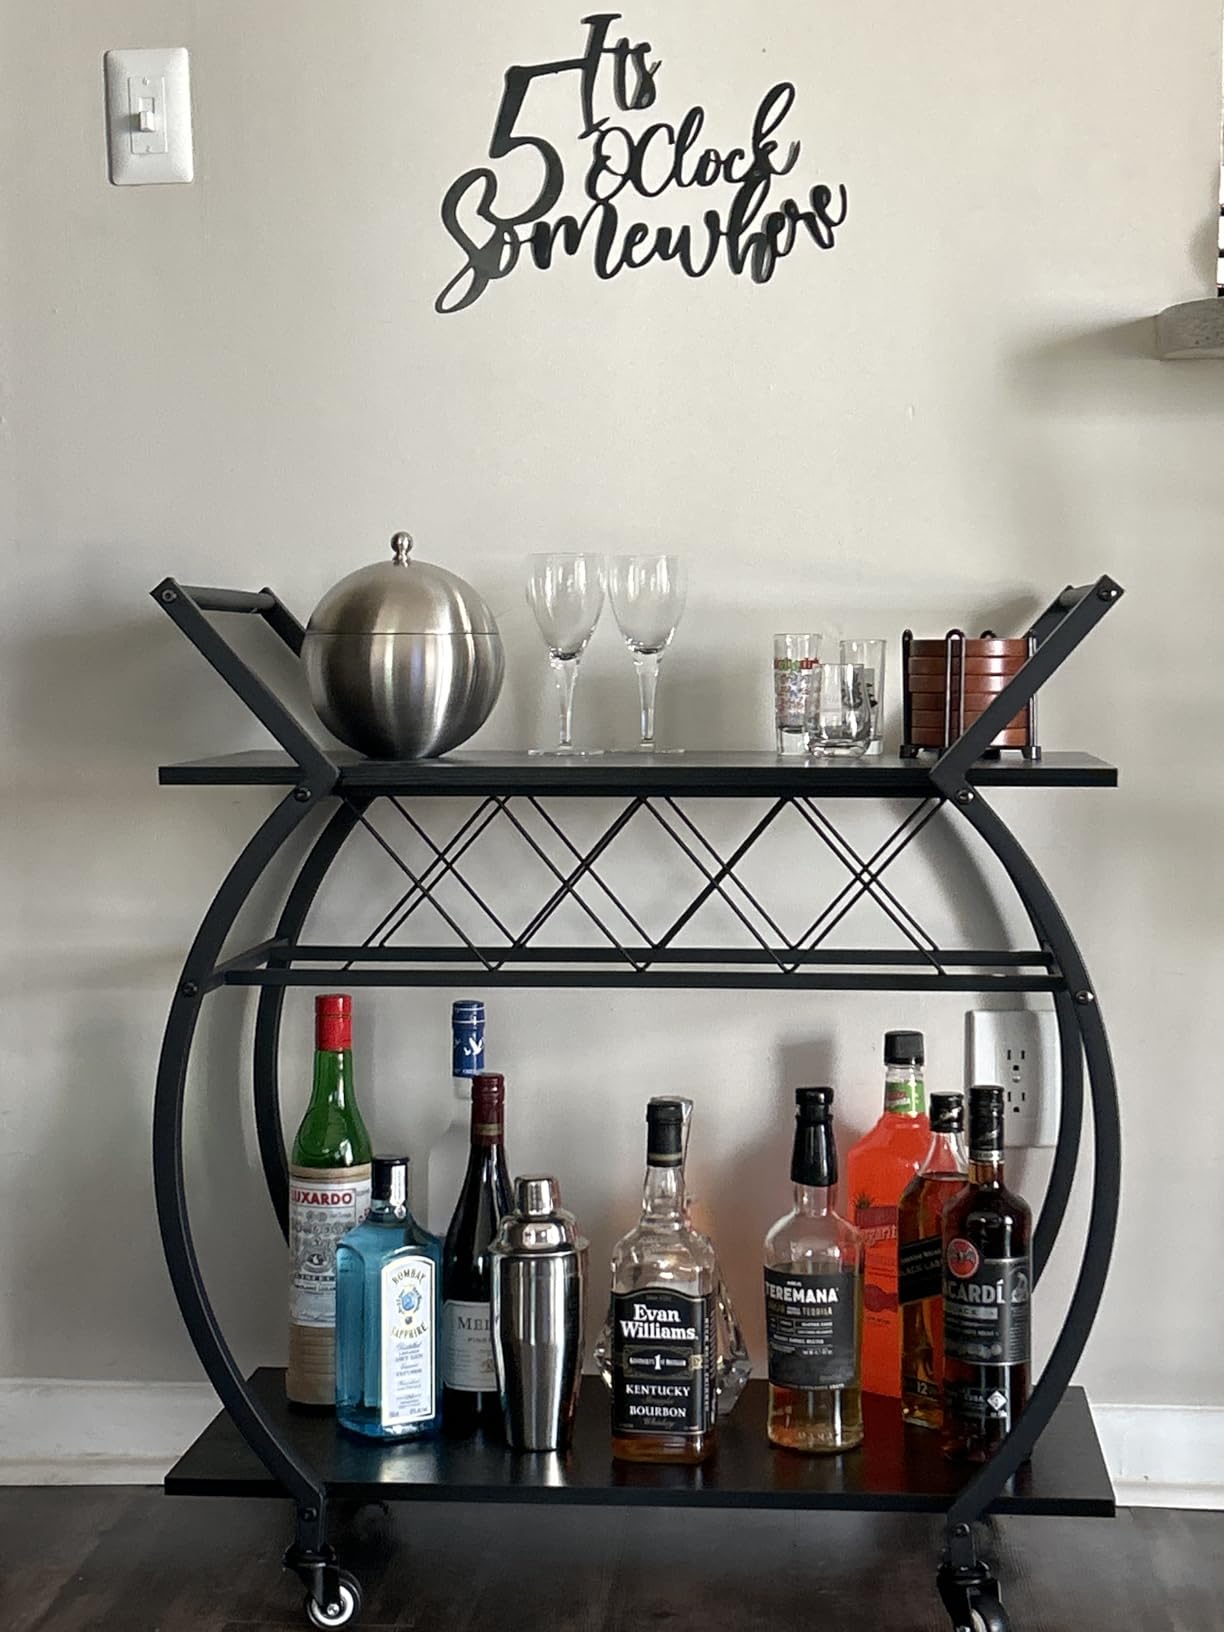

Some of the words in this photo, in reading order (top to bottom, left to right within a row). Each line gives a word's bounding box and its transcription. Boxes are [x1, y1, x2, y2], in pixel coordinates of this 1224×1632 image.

[580, 13, 662, 138] Its
[489, 58, 584, 225] 5
[435, 168, 847, 313] Somewhere
[392, 1269, 426, 1284] BOMBAY
[765, 1281, 838, 1303] TEREMANA
[633, 1303, 681, 1322] Evan
[654, 1354, 662, 1370] 1
[625, 1384, 690, 1397] KENTUCKY
[629, 1405, 687, 1418] BOURBON
